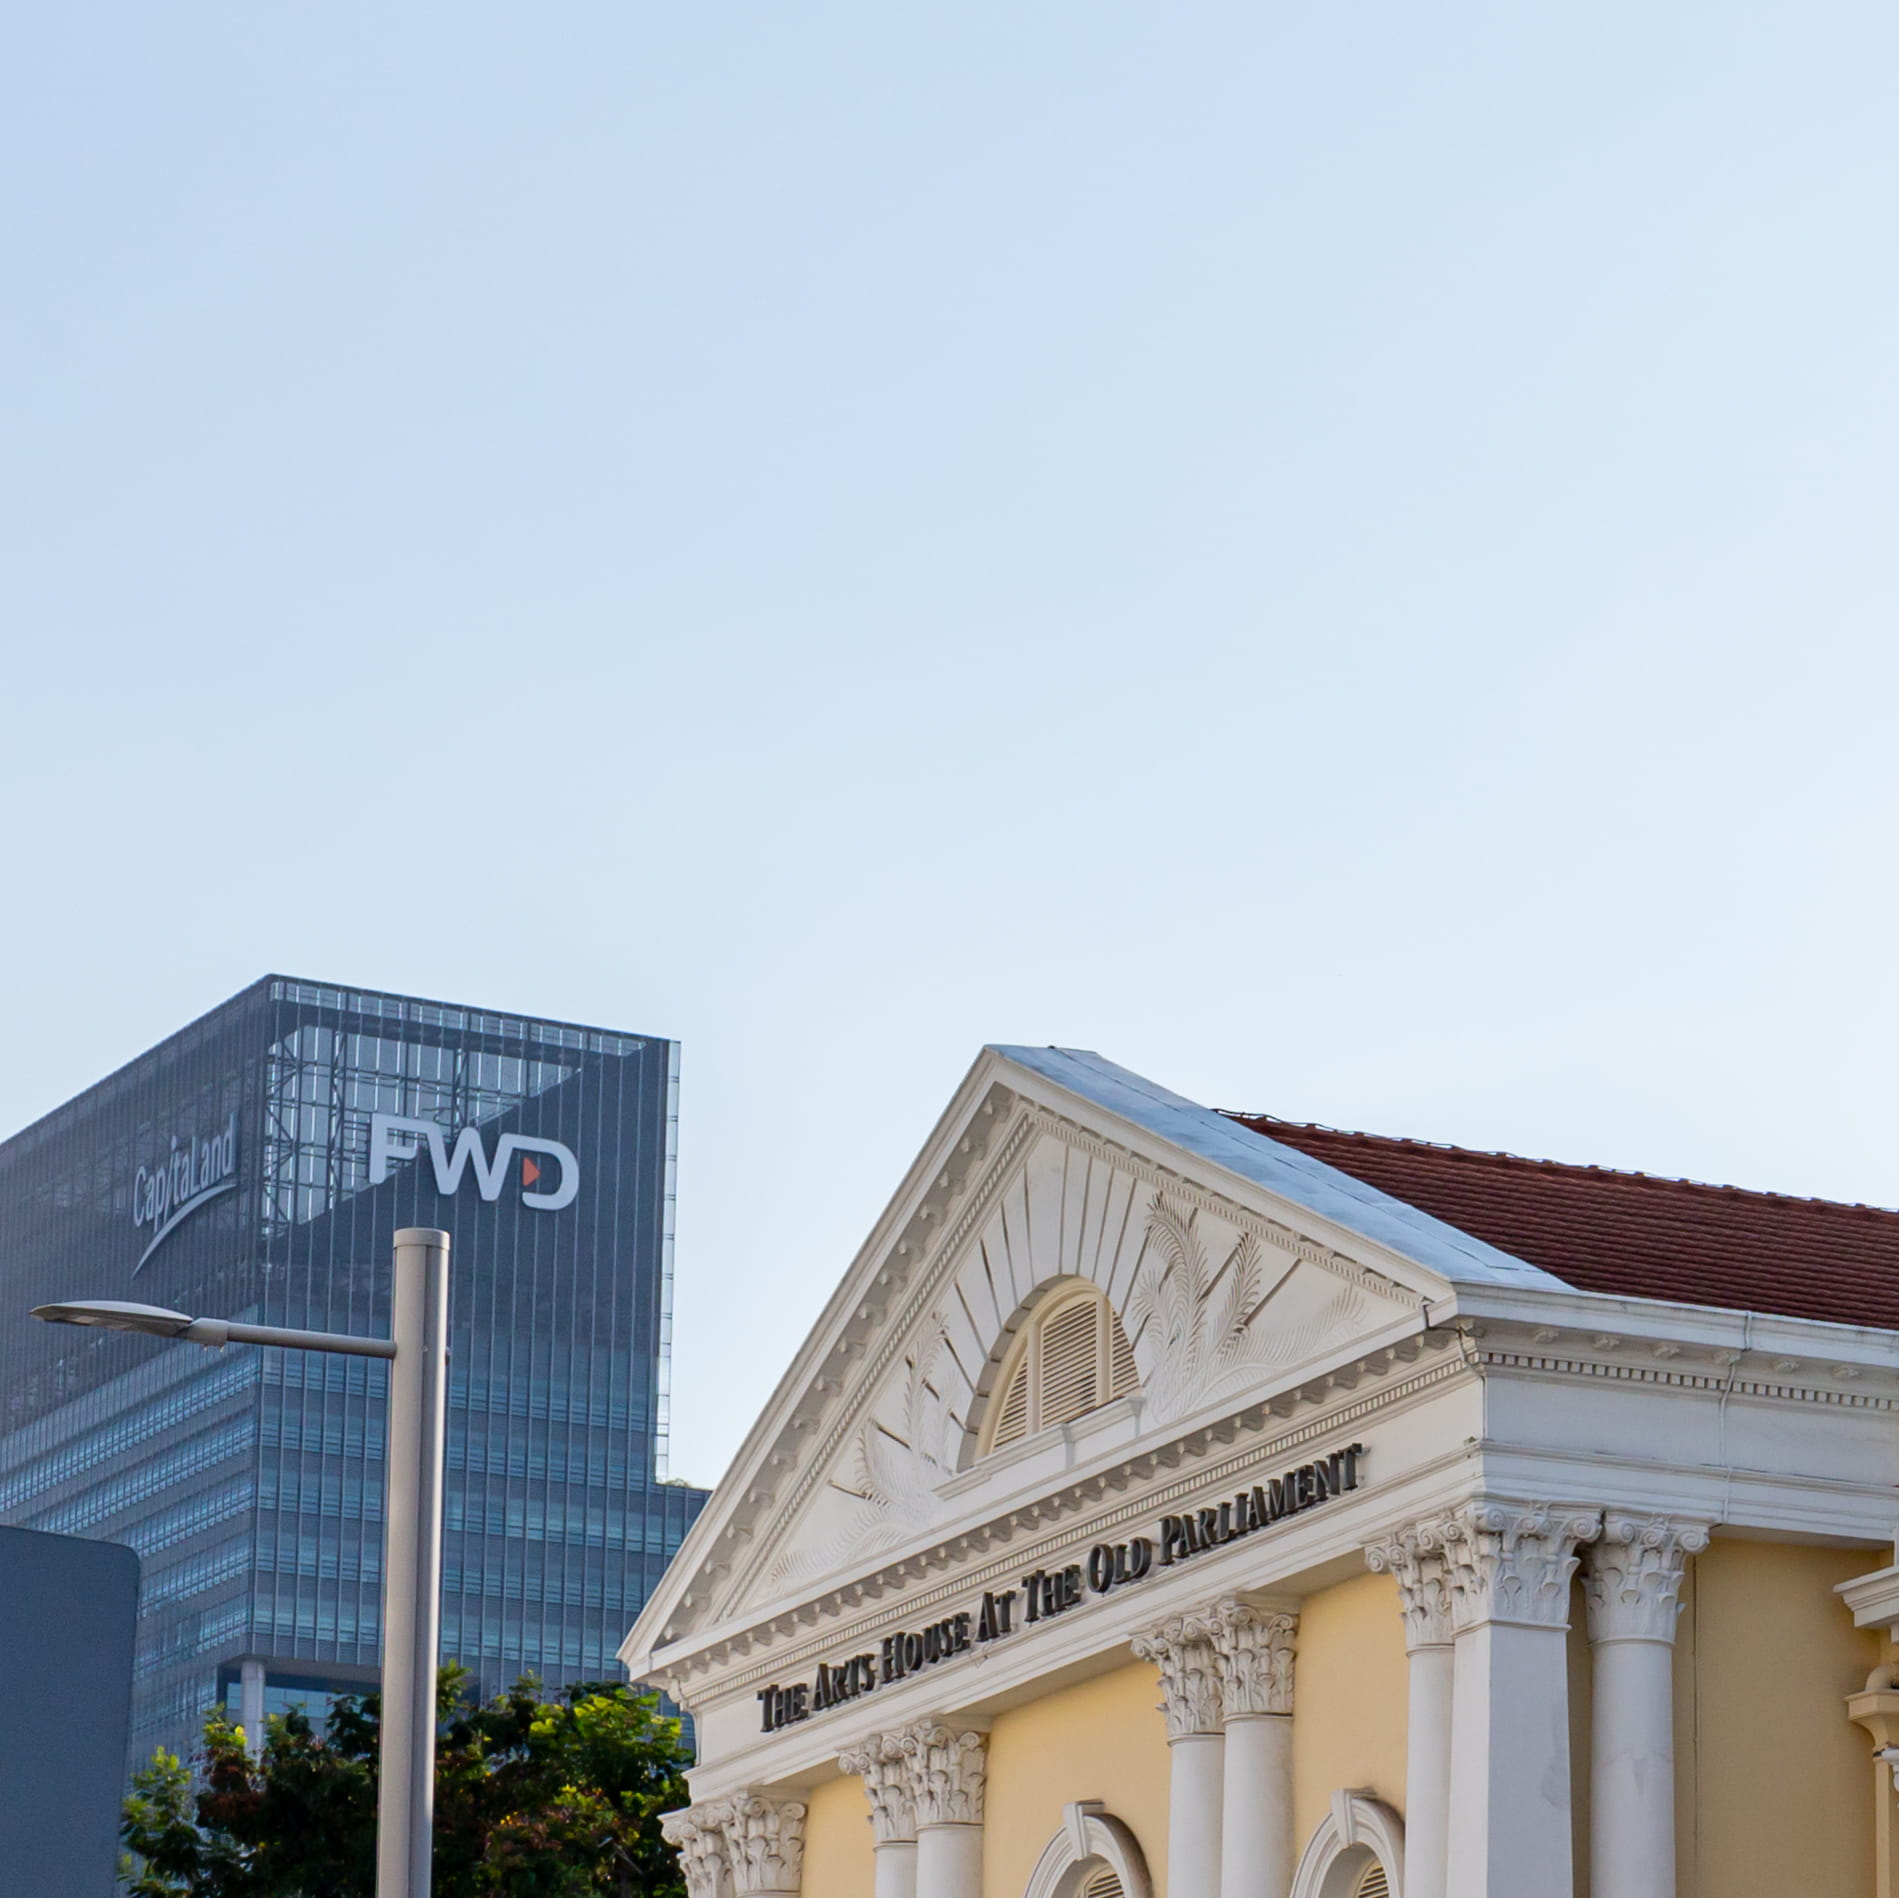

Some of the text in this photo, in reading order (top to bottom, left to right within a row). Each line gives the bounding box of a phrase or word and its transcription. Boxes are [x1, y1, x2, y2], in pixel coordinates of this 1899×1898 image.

[134, 1111, 238, 1233] CapitaLand
[369, 1113, 580, 1210] FWD
[757, 1442, 1364, 1732] THE ARTS HOUSE AT THE OLD PARLIAMENT
